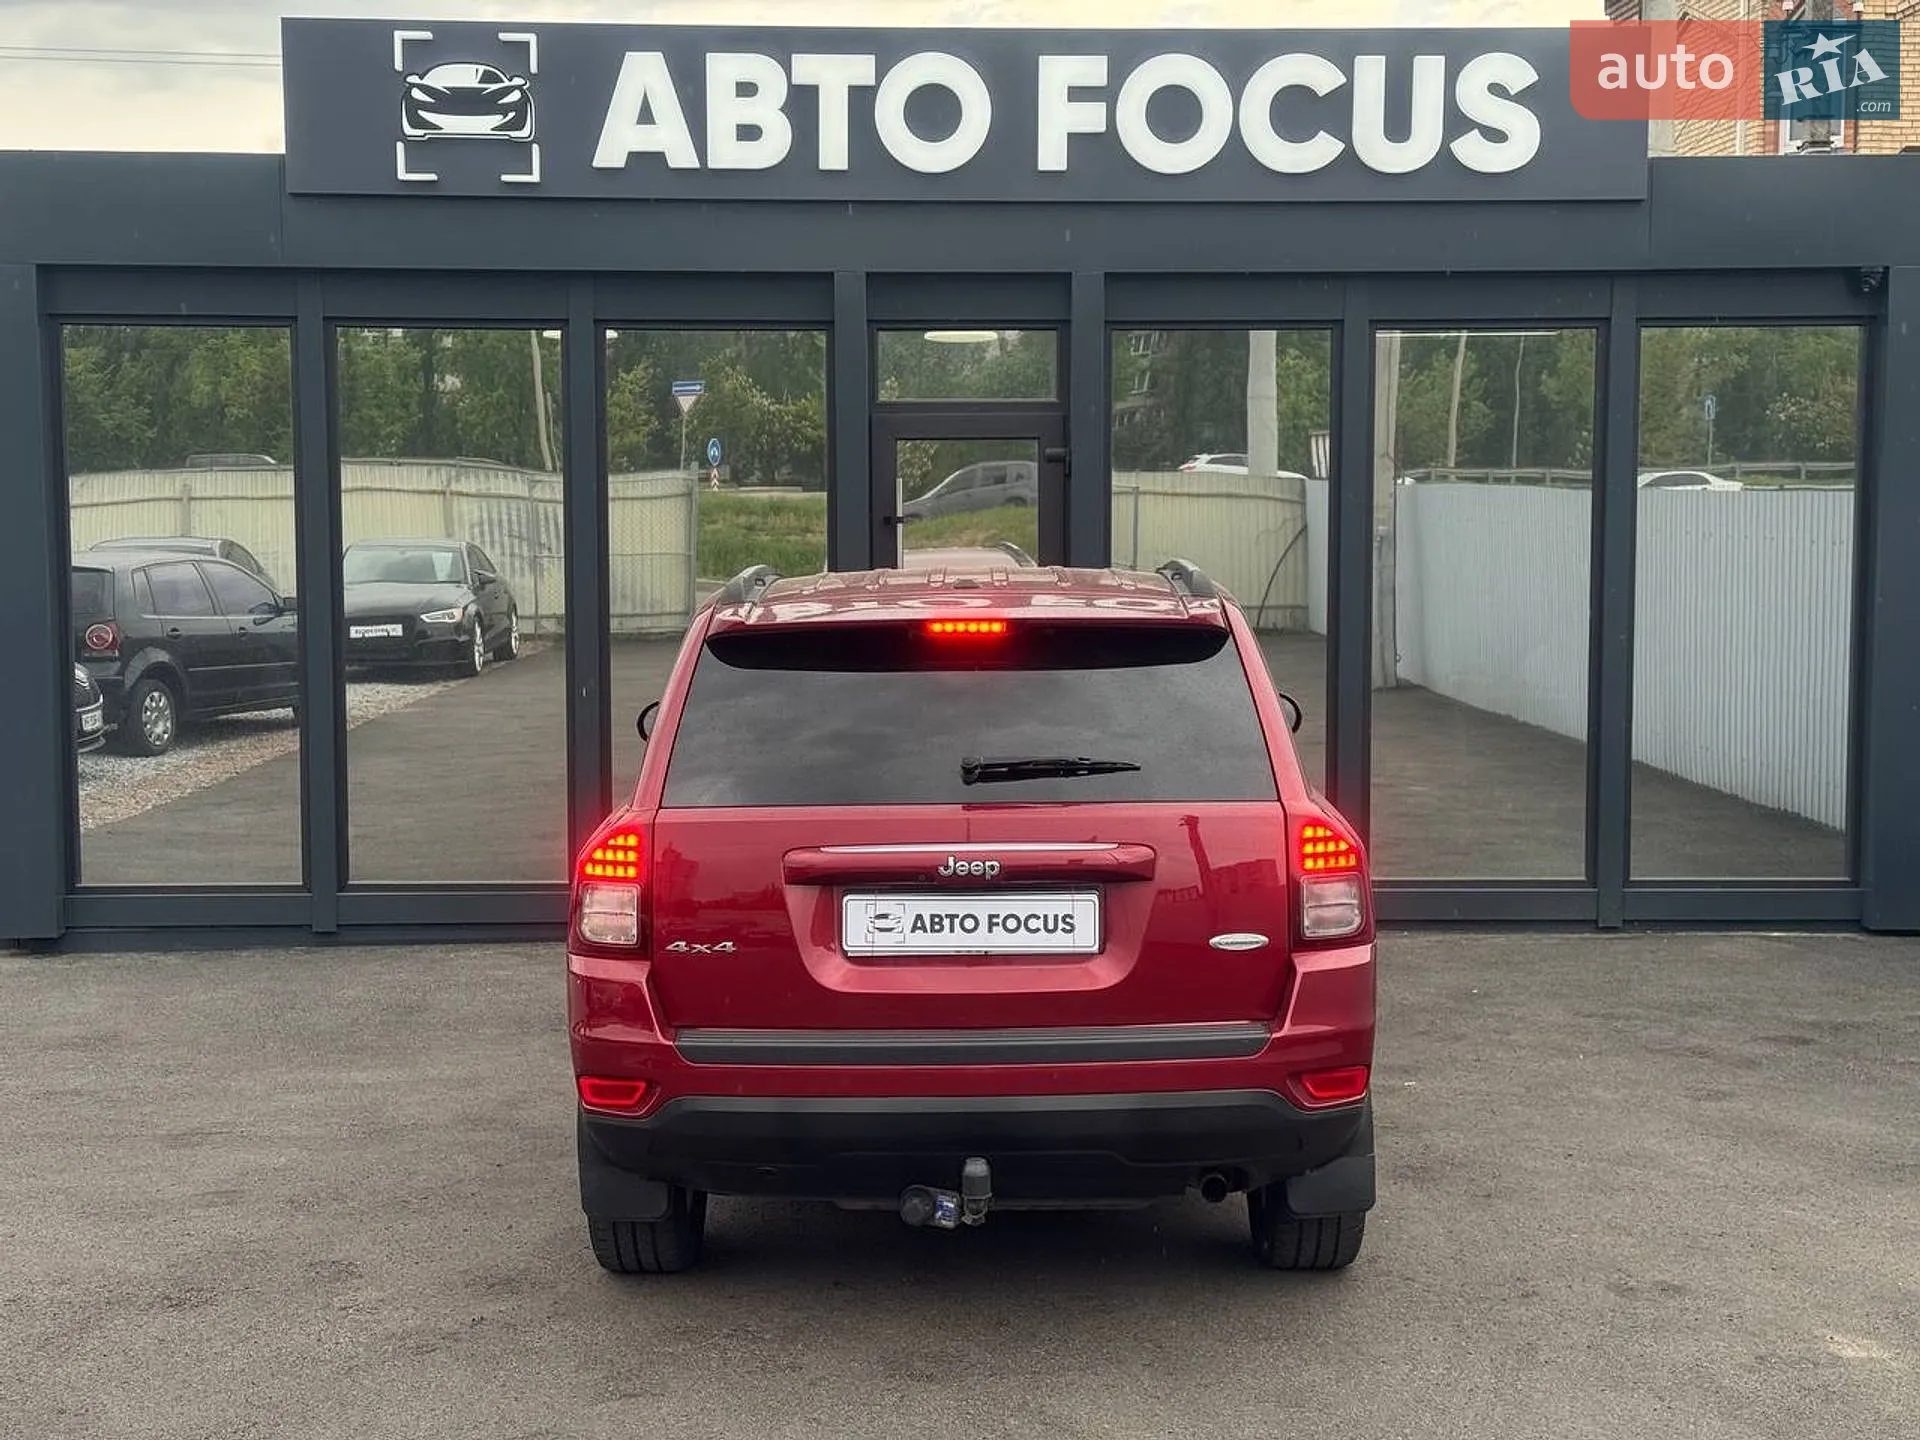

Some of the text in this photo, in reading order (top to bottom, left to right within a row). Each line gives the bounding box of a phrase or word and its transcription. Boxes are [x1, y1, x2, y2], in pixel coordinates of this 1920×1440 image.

[591, 50, 1542, 175] АВТО FOCUS
[938, 856, 1001, 880] Jeep
[910, 913, 1076, 934] АВТО FOCUS
